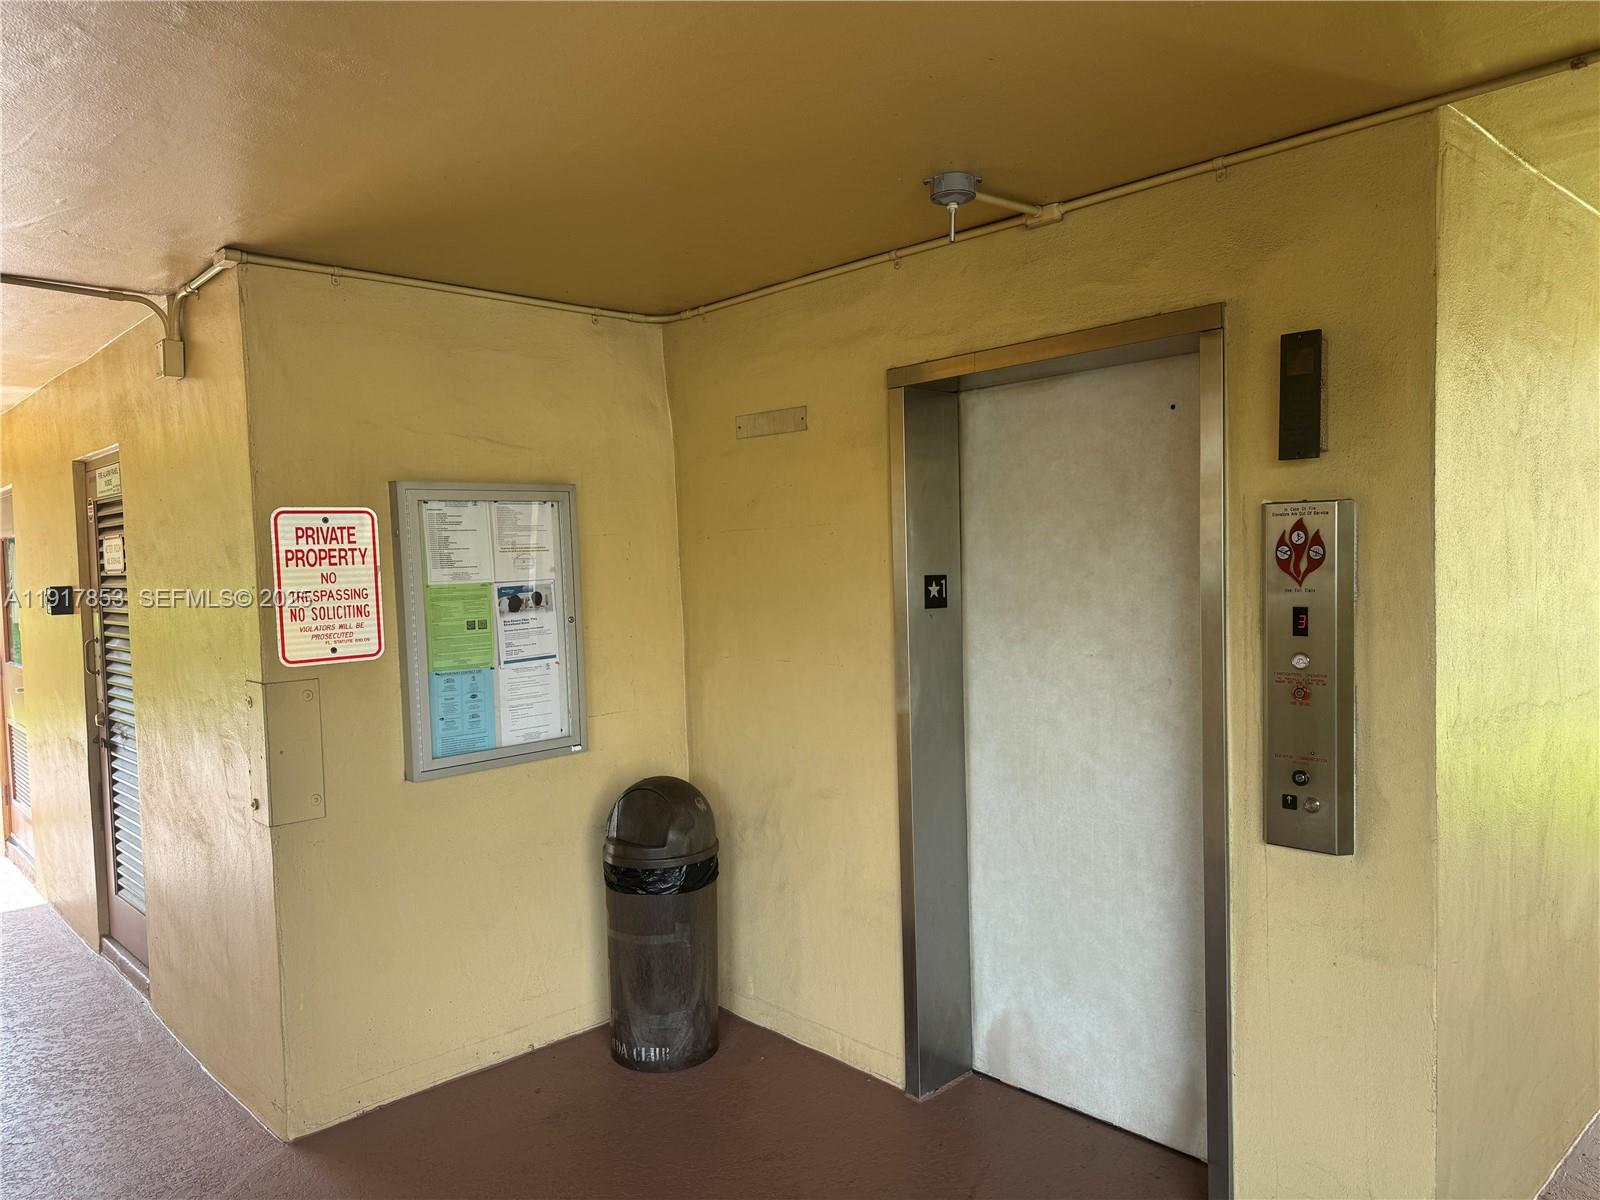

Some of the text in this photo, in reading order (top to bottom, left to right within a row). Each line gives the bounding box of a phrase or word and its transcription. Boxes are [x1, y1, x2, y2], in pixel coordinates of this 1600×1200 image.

[295, 526, 357, 545] PRIVATE
[285, 547, 368, 568] PROPERTY
[320, 571, 337, 585] NO
[288, 588, 369, 605] TRESPASSING
[941, 578, 946, 598] 1
[290, 603, 371, 622] NO SOLICITING
[299, 621, 365, 633] VIOLATORS WILL BE
[1298, 614, 1307, 629] 3
[311, 631, 354, 641] PROSECUTED
